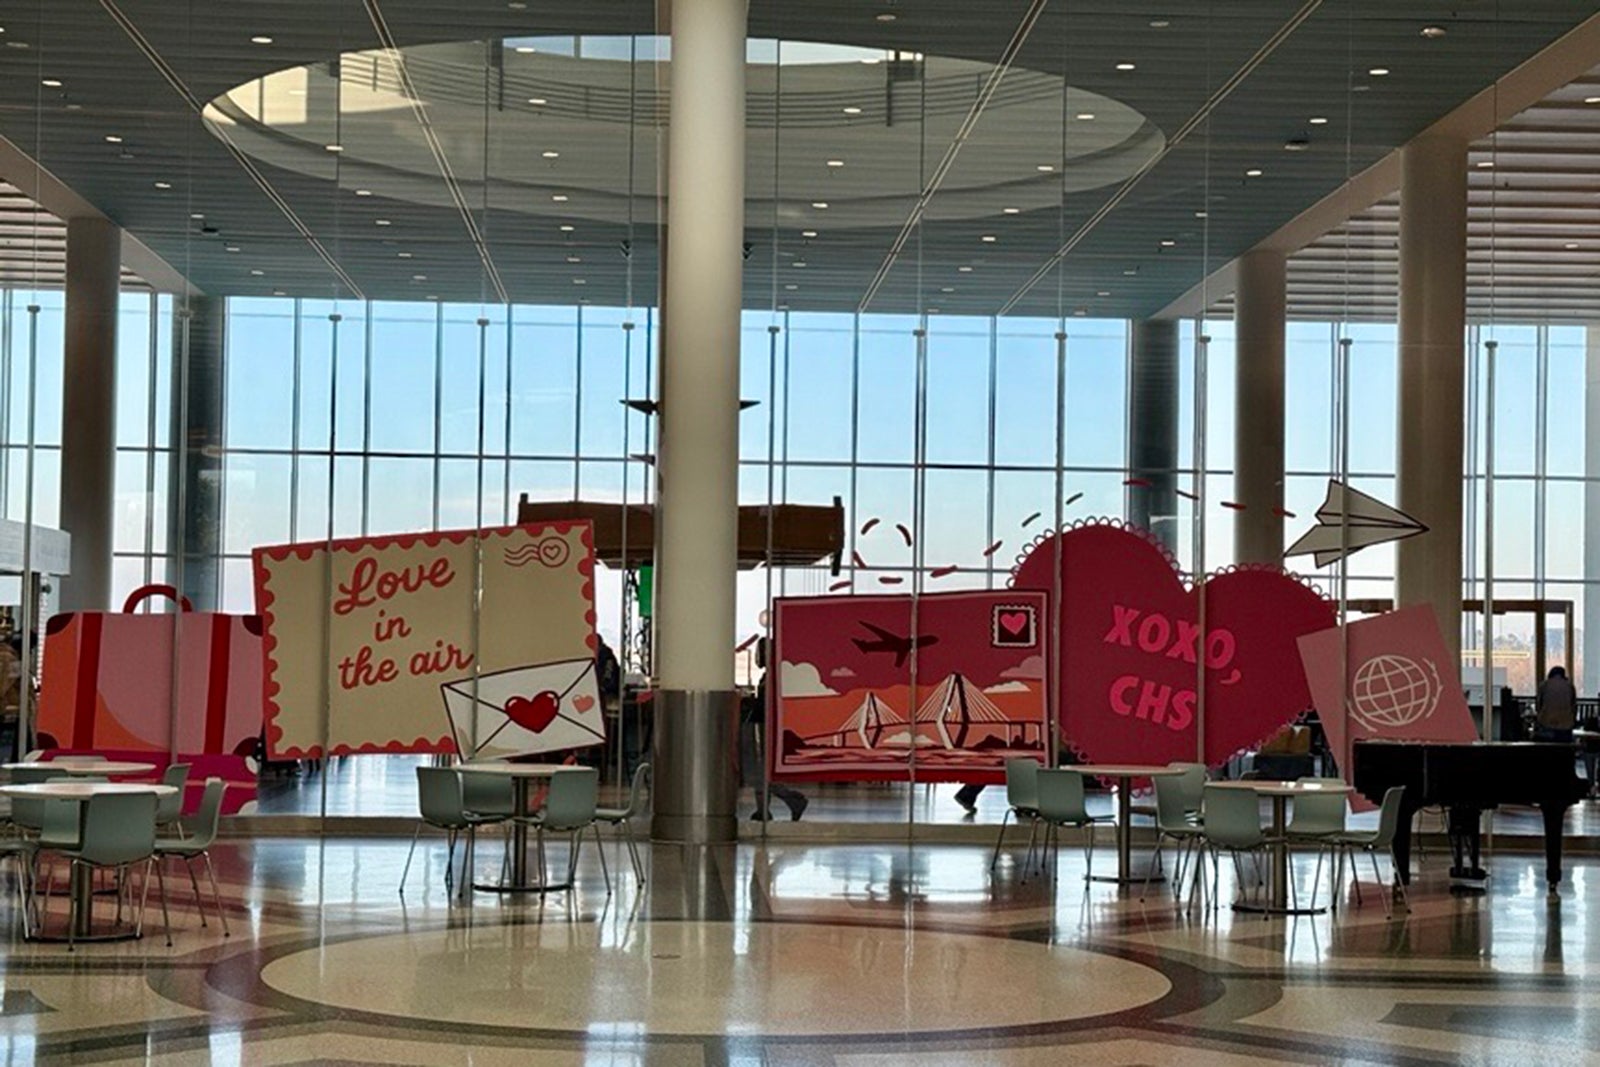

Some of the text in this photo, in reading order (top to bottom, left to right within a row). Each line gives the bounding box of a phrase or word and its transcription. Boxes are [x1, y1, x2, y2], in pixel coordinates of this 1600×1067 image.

[334, 557, 455, 616] Love
[374, 610, 412, 642] in
[1103, 604, 1242, 685] XOXO,
[338, 640, 475, 690] the air
[1109, 675, 1198, 731] CHS
